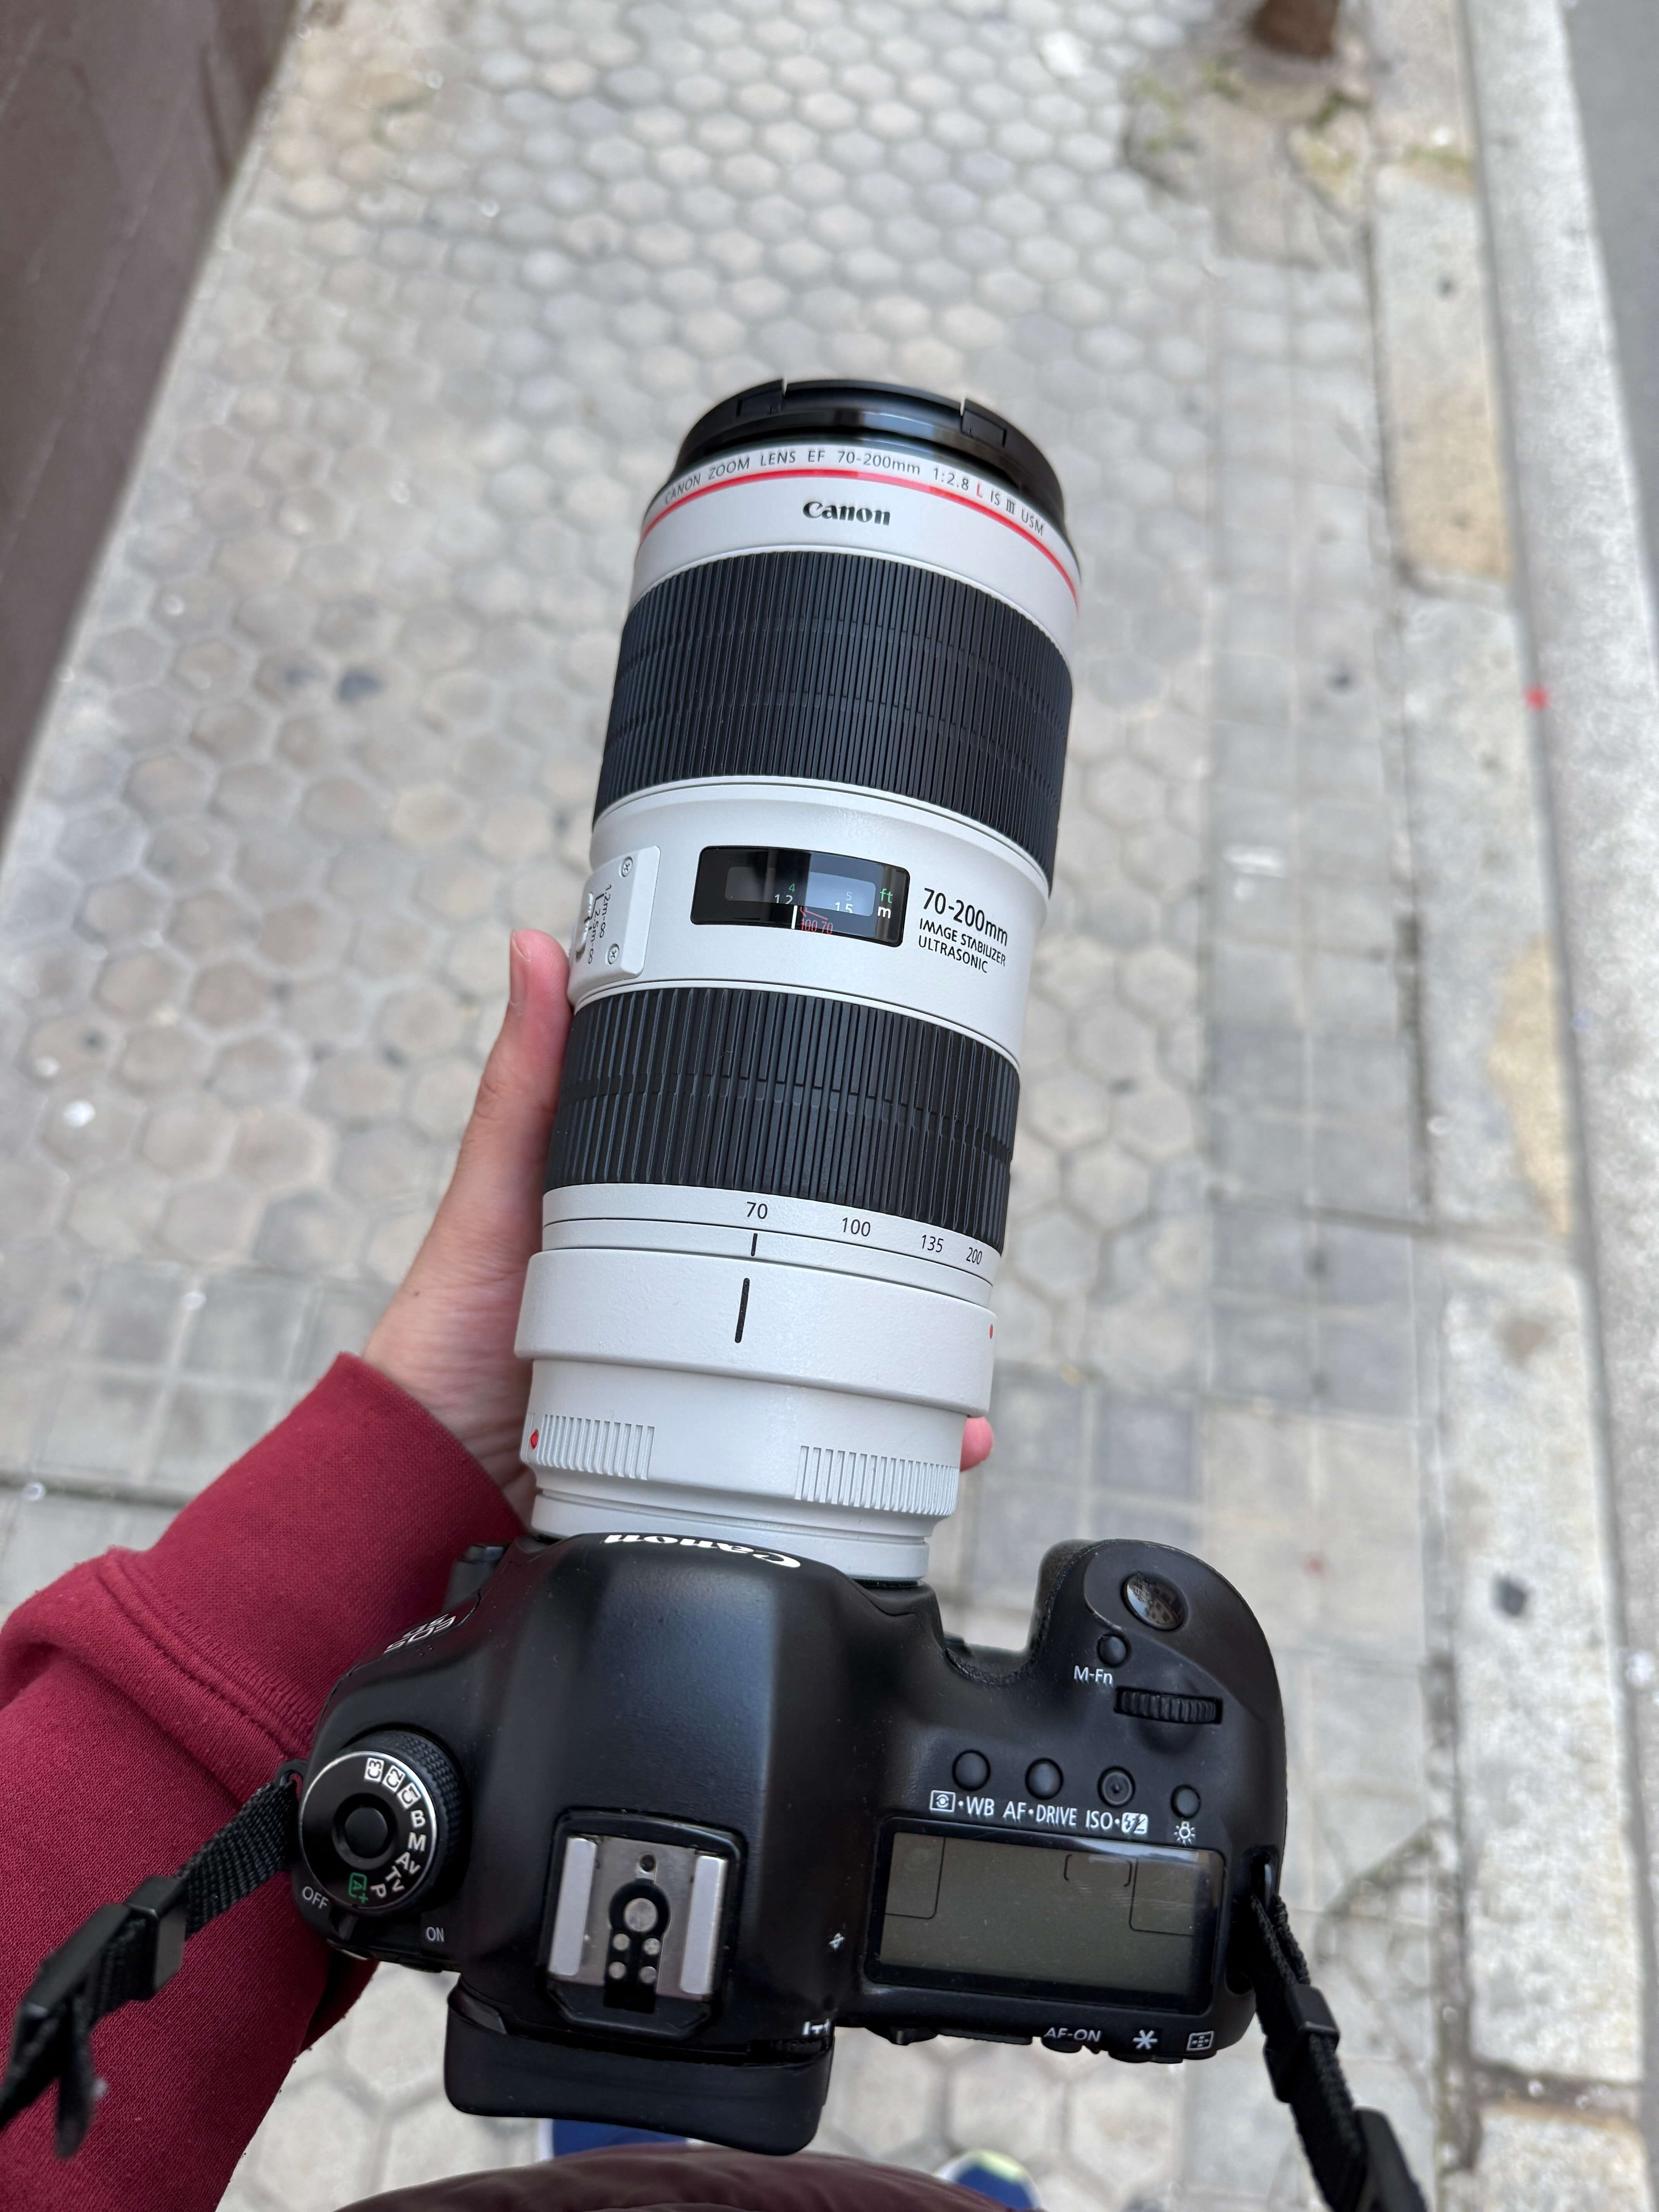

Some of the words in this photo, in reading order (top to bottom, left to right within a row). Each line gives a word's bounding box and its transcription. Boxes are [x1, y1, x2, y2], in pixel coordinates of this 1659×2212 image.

[665, 474, 701, 504] CANON
[708, 456, 750, 480] ZOOM
[760, 451, 796, 467] LENS
[808, 450, 826, 462] EF
[837, 450, 921, 476] 70-200mm
[933, 468, 969, 491] 1:2.8
[976, 483, 982, 498] L
[990, 489, 1001, 506] IS
[1021, 507, 1043, 536] USM
[803, 501, 891, 526] Canon
[788, 883, 795, 893] 4
[845, 891, 852, 901] 5
[879, 888, 893, 903] ft
[877, 906, 891, 919] m
[923, 887, 1008, 946] 70-200mm
[800, 918, 818, 933] 100
[821, 921, 833, 934] 70
[919, 918, 958, 942] IMAGE
[960, 933, 1006, 967] STABILIZER
[918, 935, 988, 973] ULTRASONIC
[746, 1201, 768, 1219] 70
[842, 1217, 871, 1237] 100
[921, 1234, 944, 1253] 135
[965, 1247, 982, 1265] 200
[603, 1534, 801, 1568] Canon
[383, 1616, 457, 1654] EOS
[1073, 1665, 1113, 1685] M-Fn
[367, 1760, 382, 1779] C3
[386, 1767, 404, 1788] C2
[401, 1784, 419, 1804] C1
[410, 1809, 426, 1828] B
[407, 1832, 427, 1851] M
[395, 1851, 421, 1874] Av
[385, 1865, 405, 1892] Tv
[302, 1886, 330, 1910] OFF
[370, 1883, 387, 1898] P
[426, 1927, 444, 1943] ON
[1044, 2027, 1102, 2042] AF-ON
